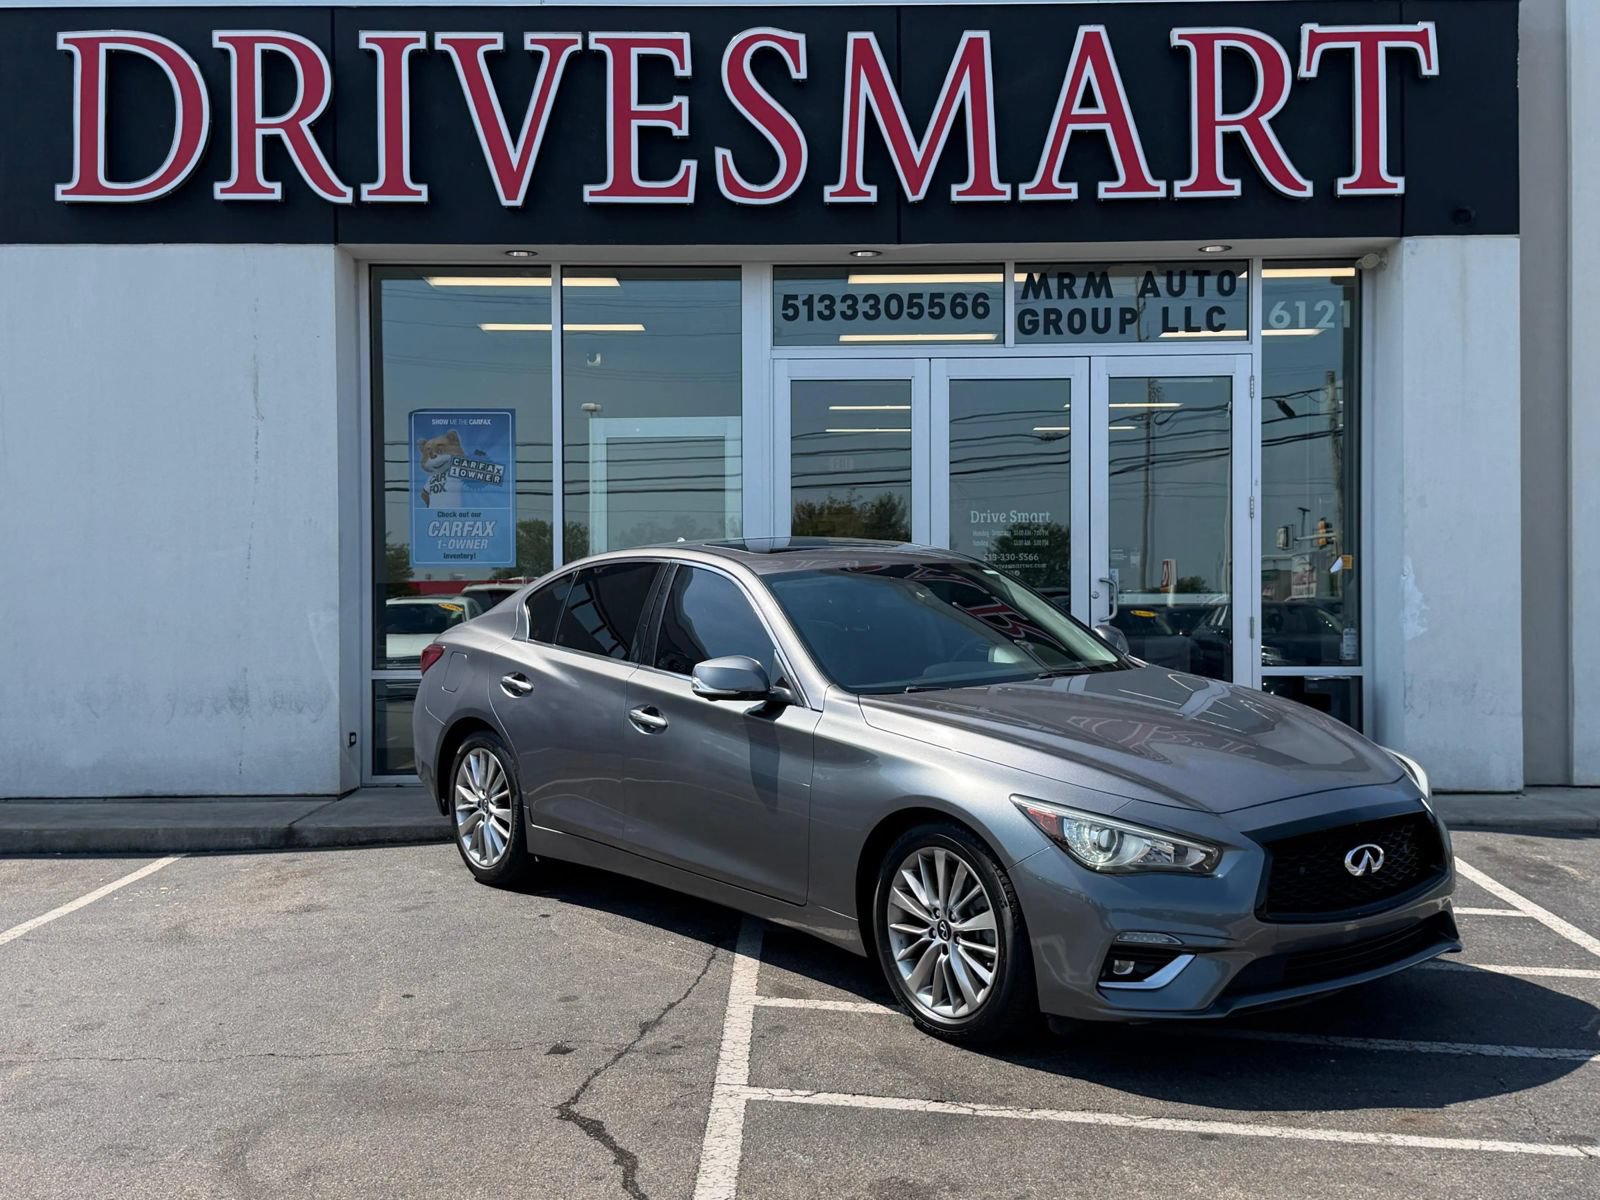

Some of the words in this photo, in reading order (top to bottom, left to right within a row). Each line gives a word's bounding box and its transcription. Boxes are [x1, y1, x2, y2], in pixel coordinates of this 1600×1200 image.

[54, 21, 1441, 208] DRIVESMART
[1021, 272, 1114, 299] MRM
[1138, 269, 1236, 298] AUTO
[781, 292, 990, 322] 5133305566
[1017, 307, 1138, 336] GROUP
[1161, 305, 1226, 333] LLC
[1268, 300, 1351, 328] 6121
[453, 458, 504, 476] CARFAX
[428, 520, 496, 537] CARFAX
[970, 509, 1007, 523] Drive
[1009, 510, 1051, 523] Smart
[437, 539, 489, 550] 1-OWNER
